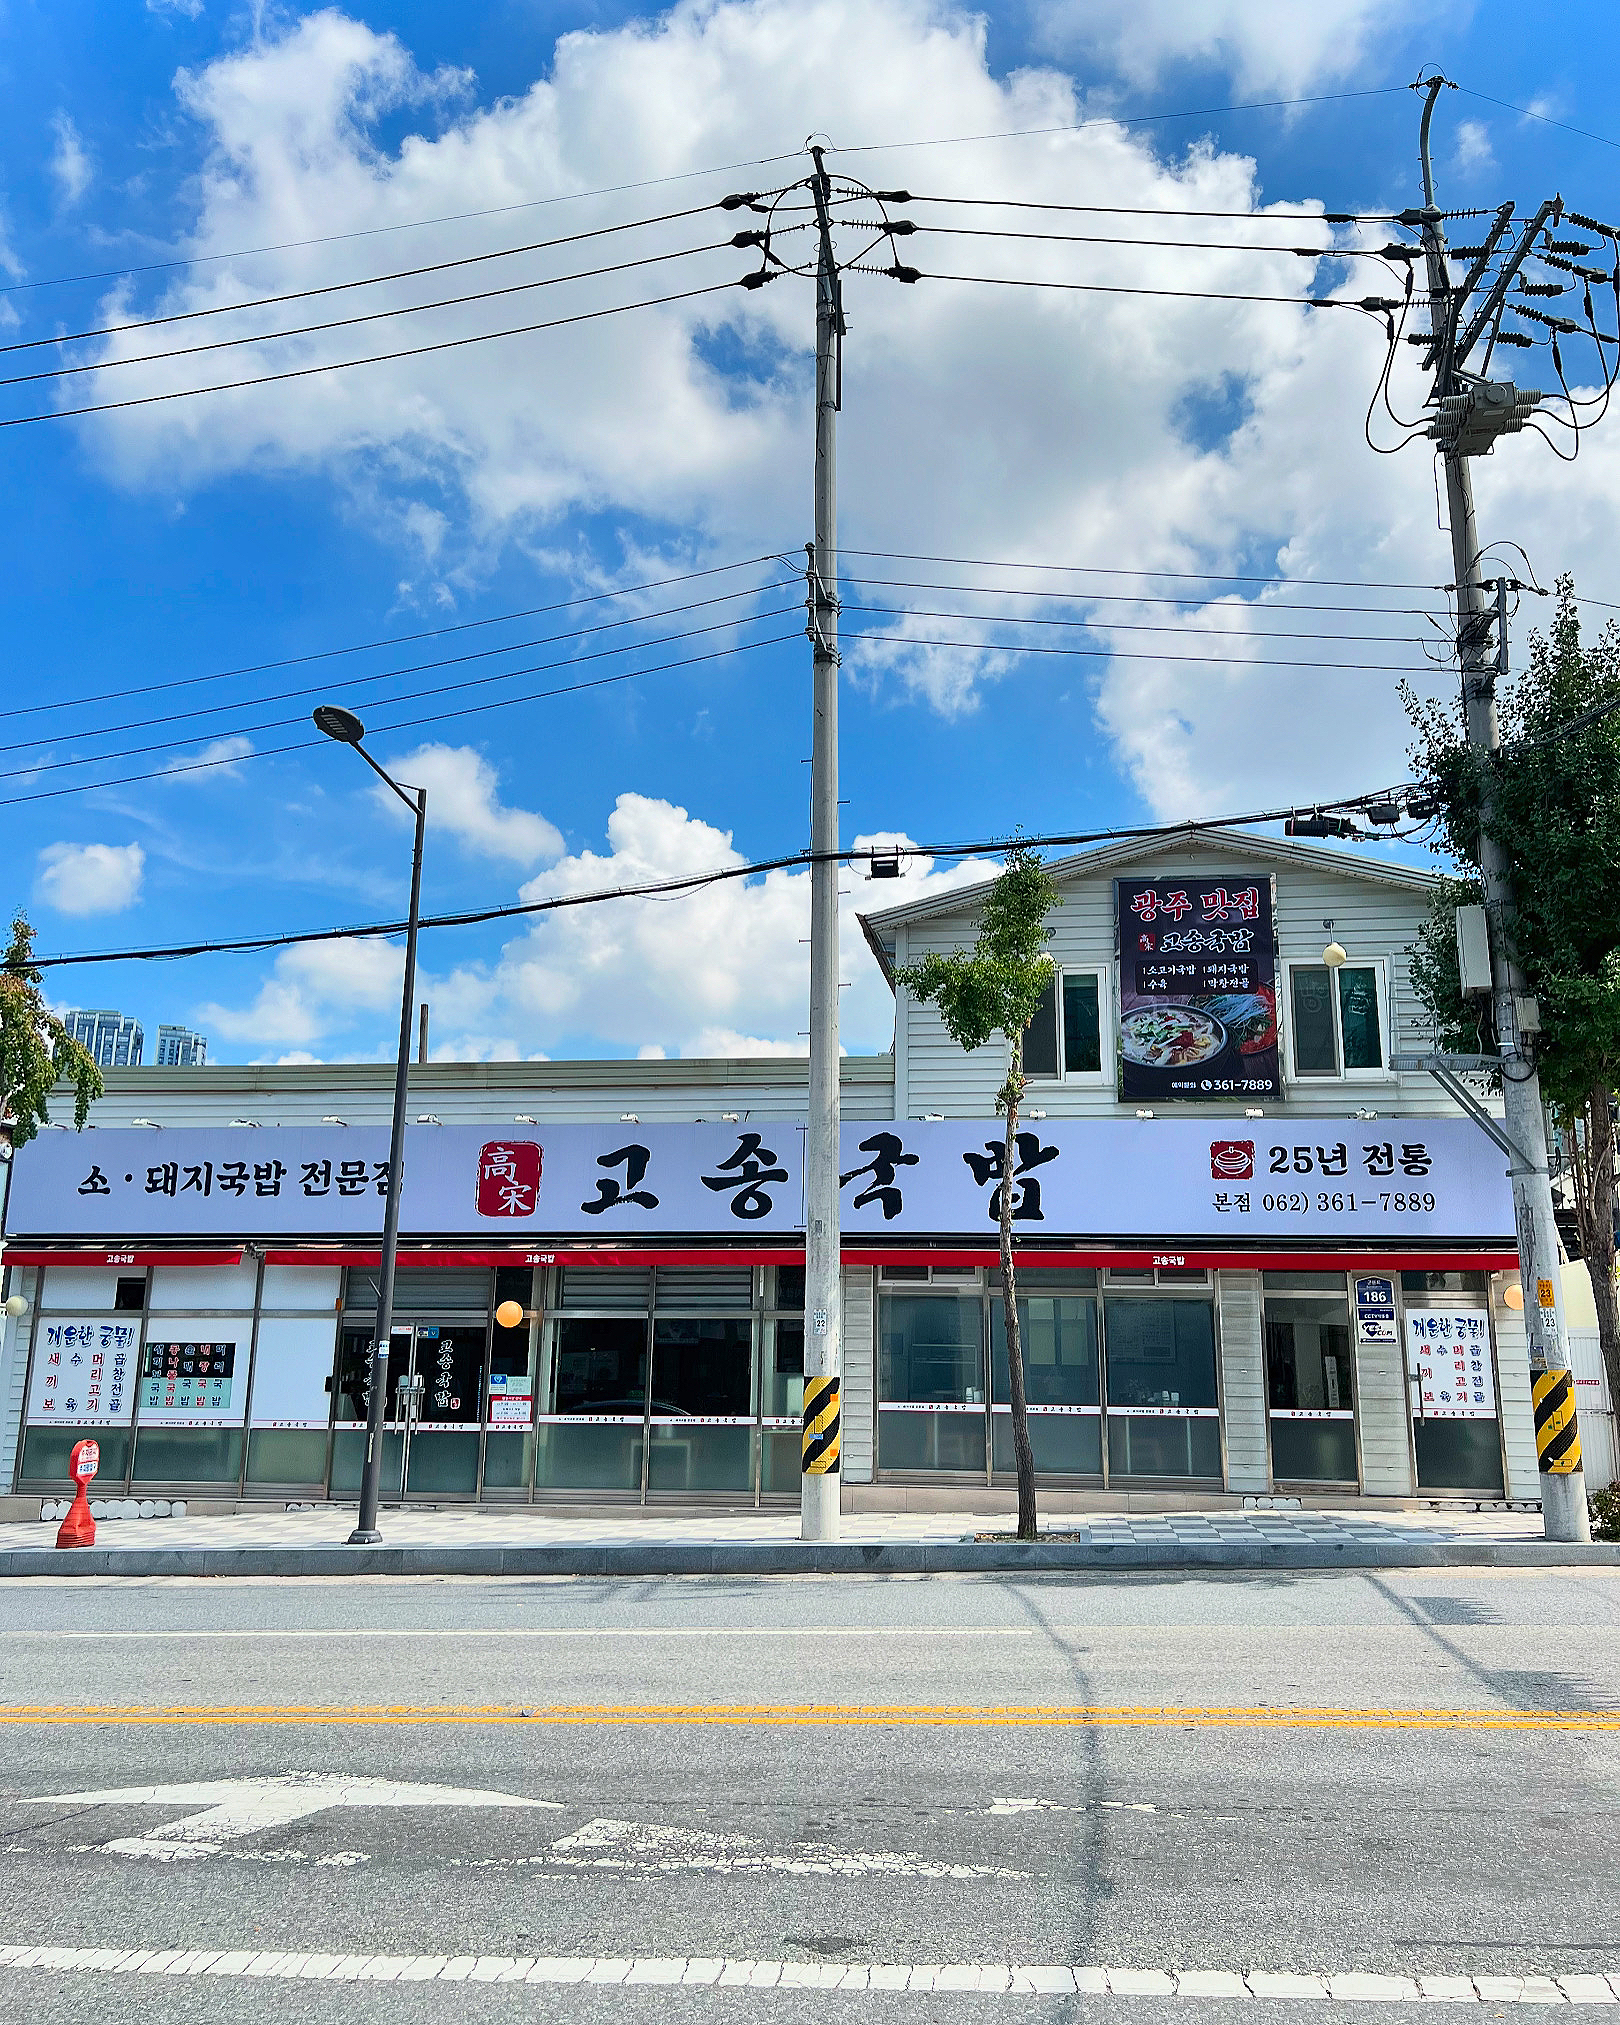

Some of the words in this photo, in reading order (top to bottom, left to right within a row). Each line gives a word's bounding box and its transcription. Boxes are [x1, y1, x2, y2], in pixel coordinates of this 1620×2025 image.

[1131, 890, 1192, 921] 광주
[1200, 887, 1259, 920] 맛집
[1160, 928, 1254, 952] 고송국밥
[1147, 963, 1196, 976] 소고기국밥
[1207, 963, 1249, 975] 돼지국밥
[1148, 978, 1168, 990] 수육
[1213, 1079, 1273, 1091] 361-7889
[1269, 1142, 1348, 1176] 25년
[1361, 1142, 1433, 1177] 전통
[484, 1146, 532, 1215] 高宋
[1212, 1192, 1251, 1213] 본점
[1262, 1191, 1309, 1214] 062)
[1317, 1192, 1436, 1213] 361-7889
[106, 1253, 134, 1264] 고송국밥
[524, 1253, 556, 1265] 고송국밥
[1152, 1255, 1185, 1266] 고송국밥
[1363, 1291, 1387, 1303] 186
[1540, 1289, 1551, 1298] 23
[1545, 1317, 1556, 1327] 23
[1412, 1317, 1452, 1340] 개운한
[47, 1325, 94, 1348] 개운한
[435, 1339, 454, 1408] 고송국밥
